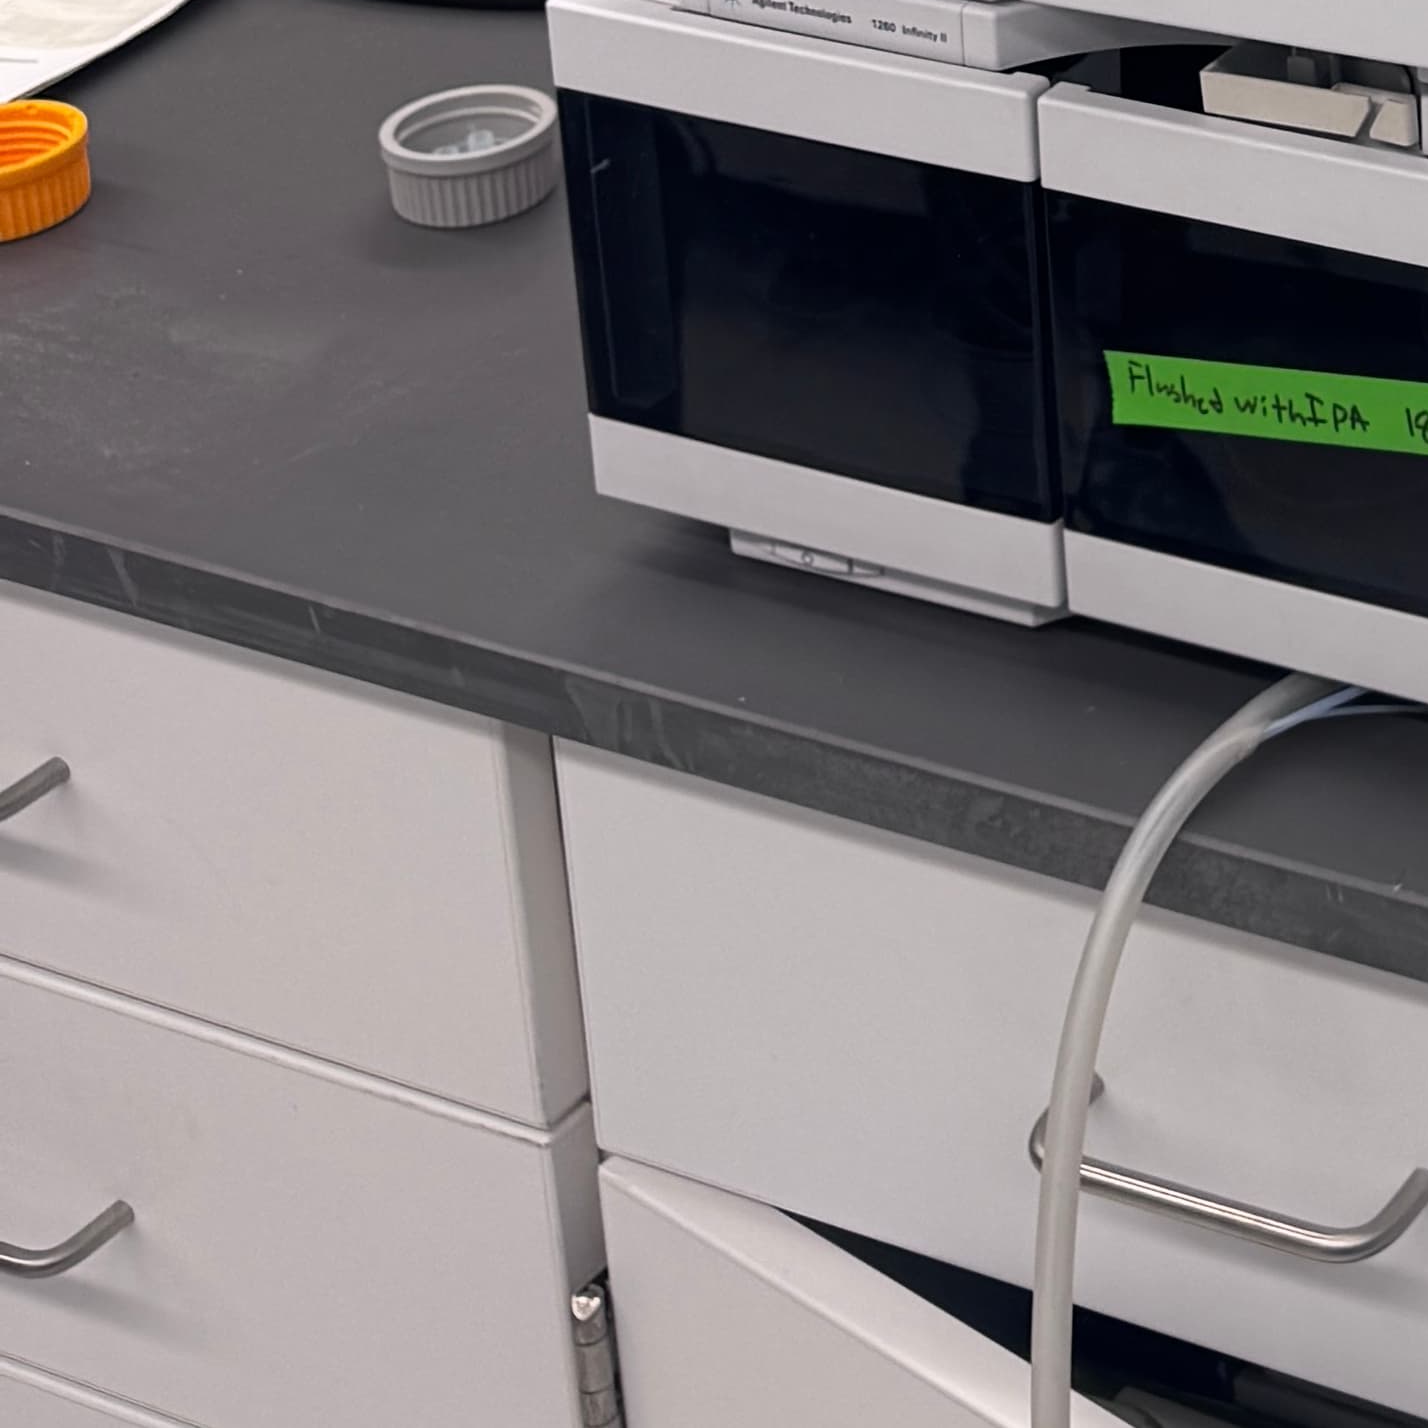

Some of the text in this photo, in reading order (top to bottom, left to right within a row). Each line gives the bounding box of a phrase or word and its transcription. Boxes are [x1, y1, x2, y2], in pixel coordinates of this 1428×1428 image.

[788, 0, 853, 25] Technologies
[871, 17, 897, 34] 1260
[901, 24, 938, 43] Infinity
[1128, 360, 1224, 416] Flushed
